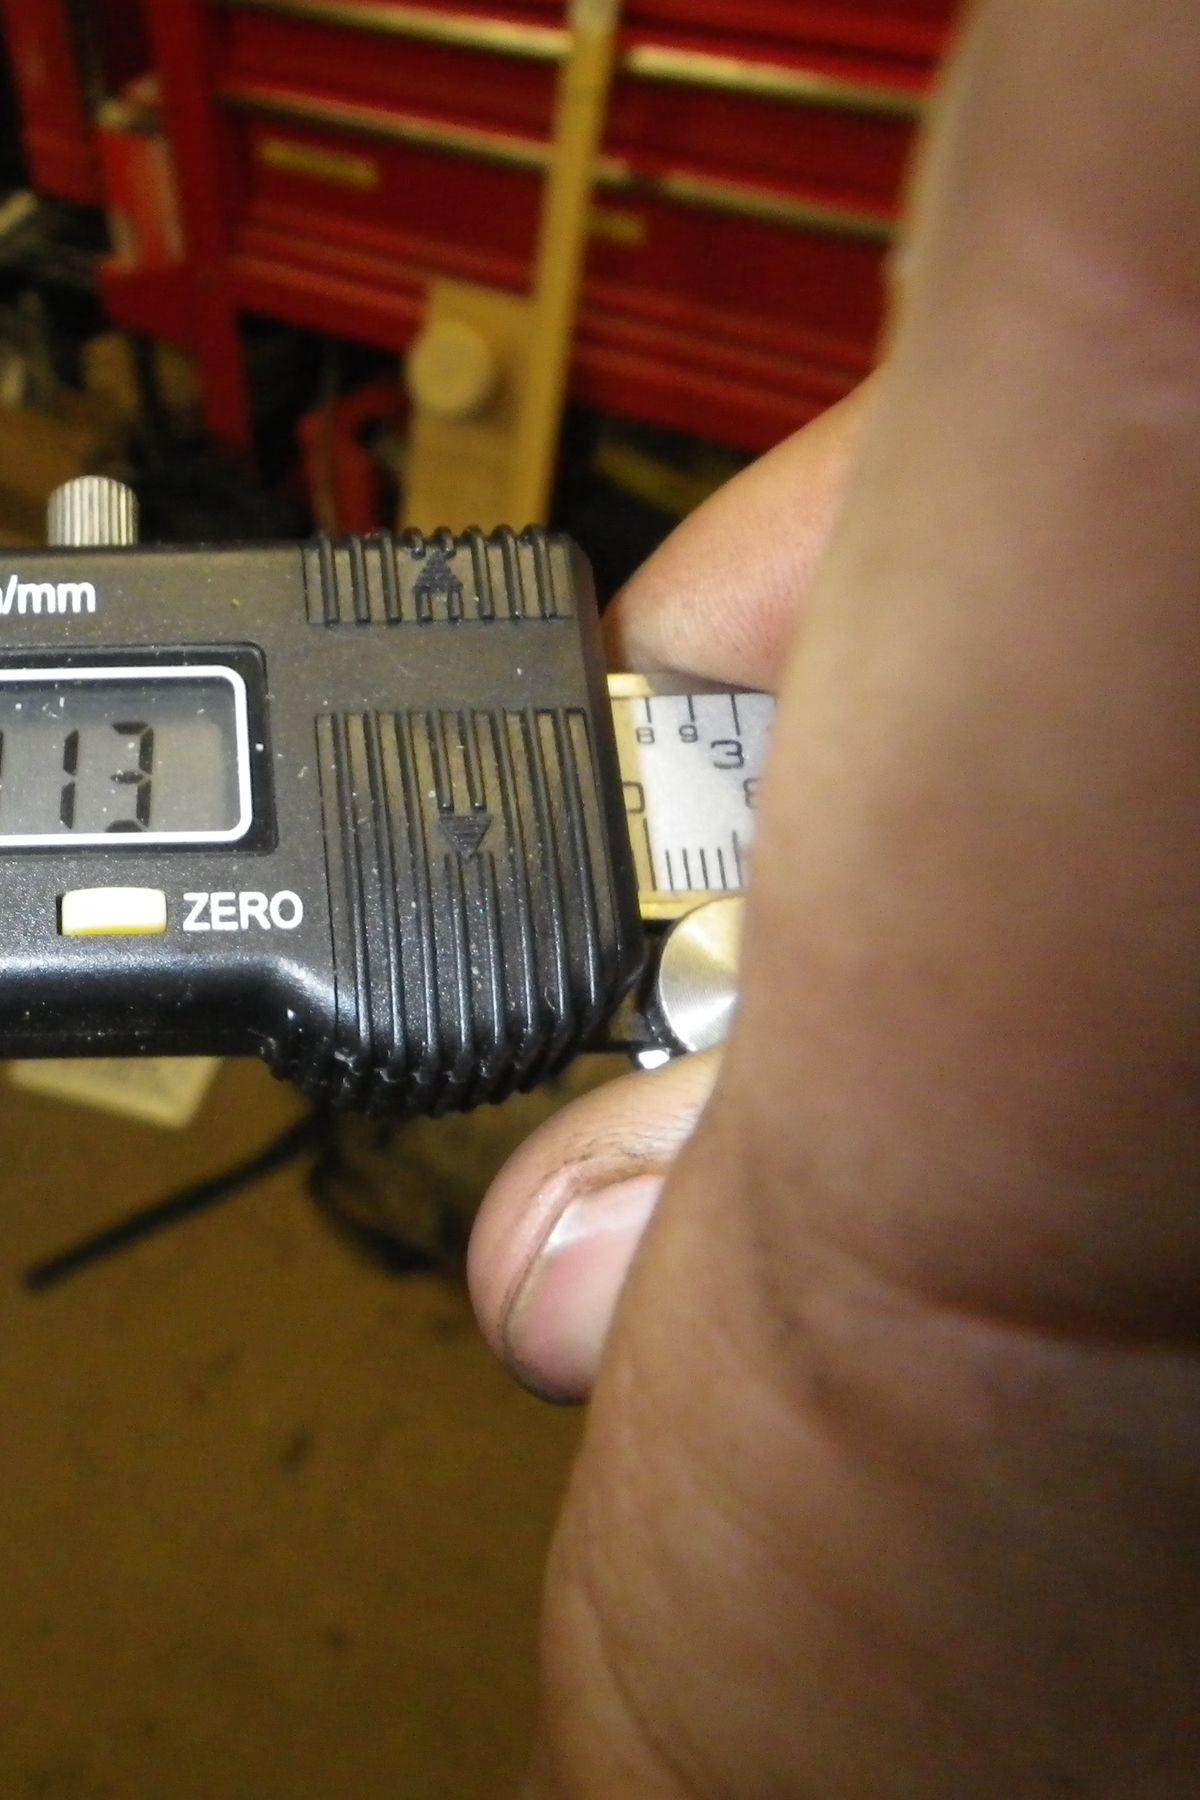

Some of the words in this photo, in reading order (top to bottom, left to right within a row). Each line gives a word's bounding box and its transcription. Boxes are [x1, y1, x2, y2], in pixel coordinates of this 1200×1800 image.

[679, 724, 699, 743] 9
[711, 739, 744, 769] 3
[183, 891, 304, 931] ZERO
